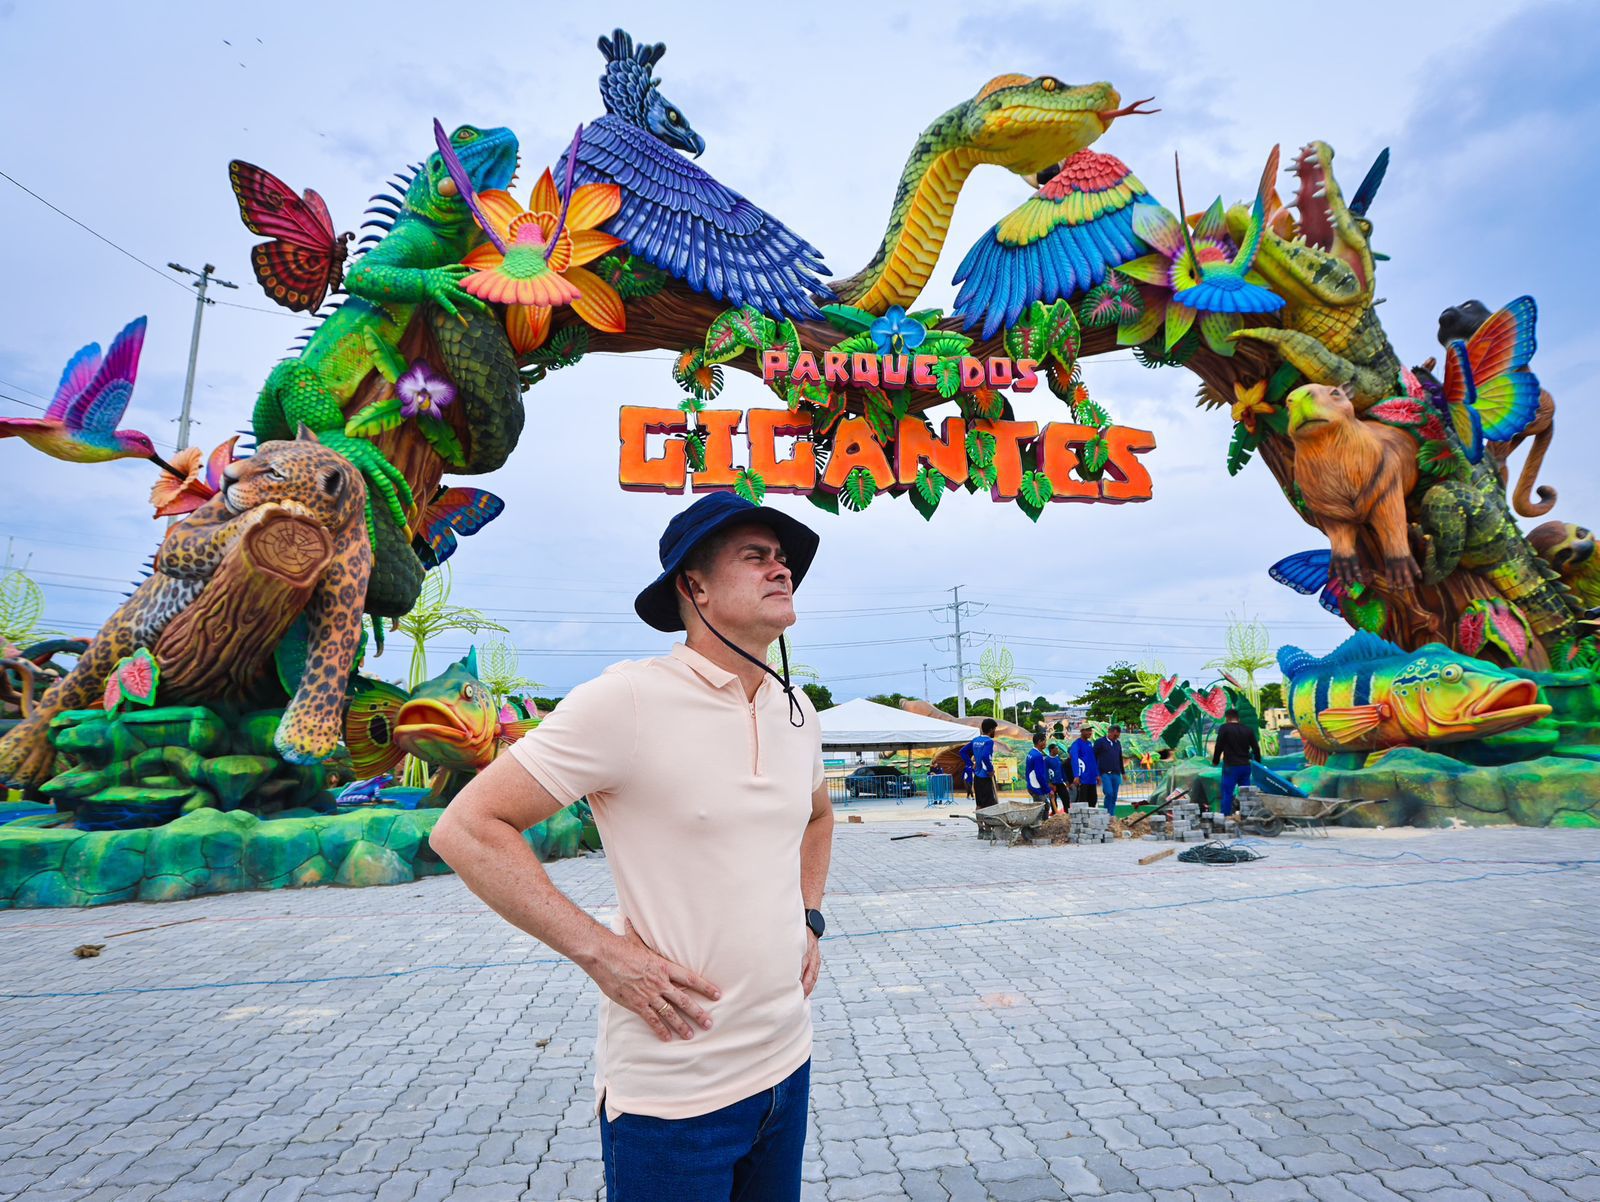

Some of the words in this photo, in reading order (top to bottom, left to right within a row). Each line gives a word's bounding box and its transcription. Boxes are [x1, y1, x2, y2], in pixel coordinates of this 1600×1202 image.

[763, 350, 939, 389] PARQUE
[959, 356, 1039, 393] DOS
[619, 405, 1156, 504] GIGANTES
